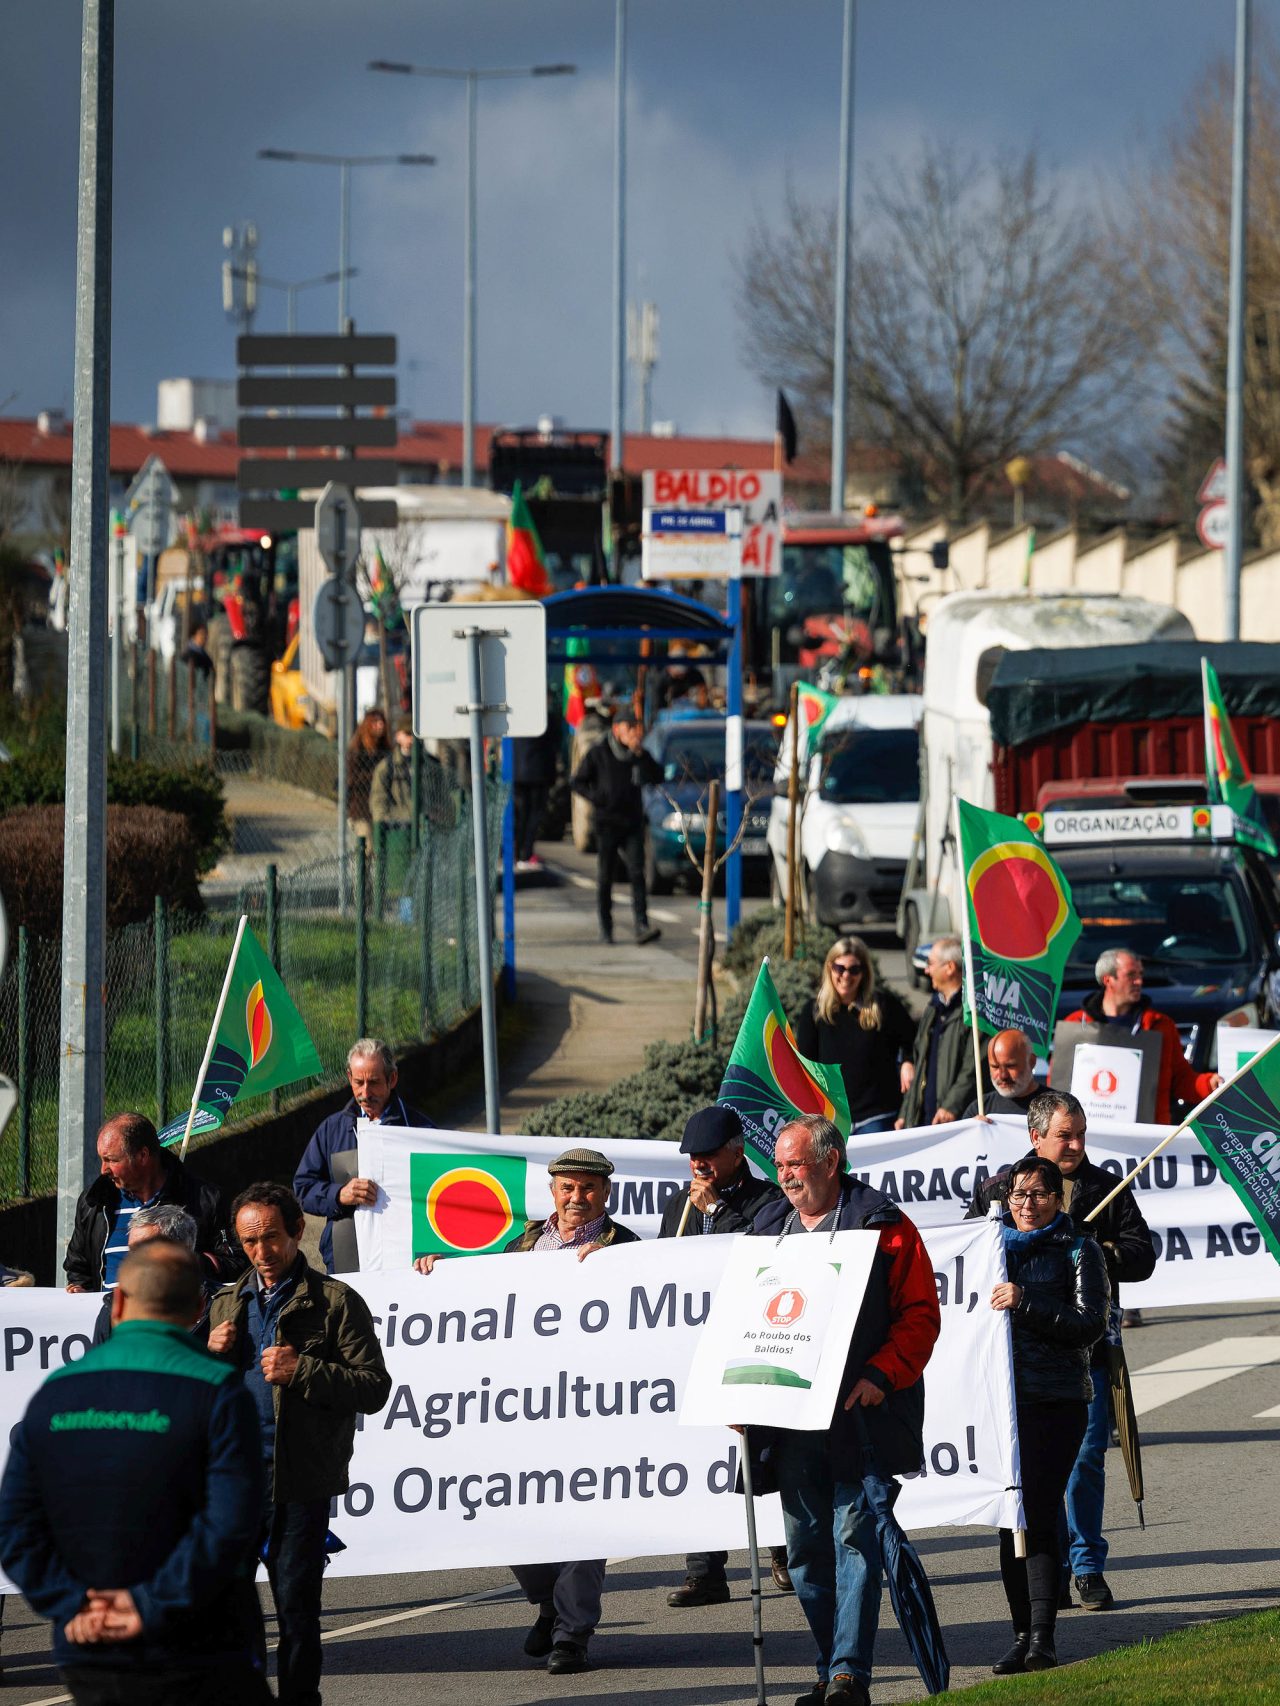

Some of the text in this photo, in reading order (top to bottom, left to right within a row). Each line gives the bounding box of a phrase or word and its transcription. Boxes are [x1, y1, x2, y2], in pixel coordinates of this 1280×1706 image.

[1053, 813, 1180, 834] ORGANIZAÇÃO
[215, 1087, 234, 1107] CON
[751, 1135, 777, 1159] AGRIC
[1215, 1113, 1270, 1186] CONFEDERAÇÃO
[1220, 1141, 1278, 1220] DA AGRICULTURA
[4, 1326, 93, 1371] Pro
[533, 1301, 562, 1336] e
[579, 1299, 610, 1333] o
[628, 1282, 711, 1330] Mu
[771, 1315, 792, 1324] STOP
[743, 1331, 812, 1342] Ao Roubo dos
[754, 1344, 794, 1355] Baldios!
[383, 1370, 676, 1439] Agricultura
[393, 1456, 689, 1521] Orçamento
